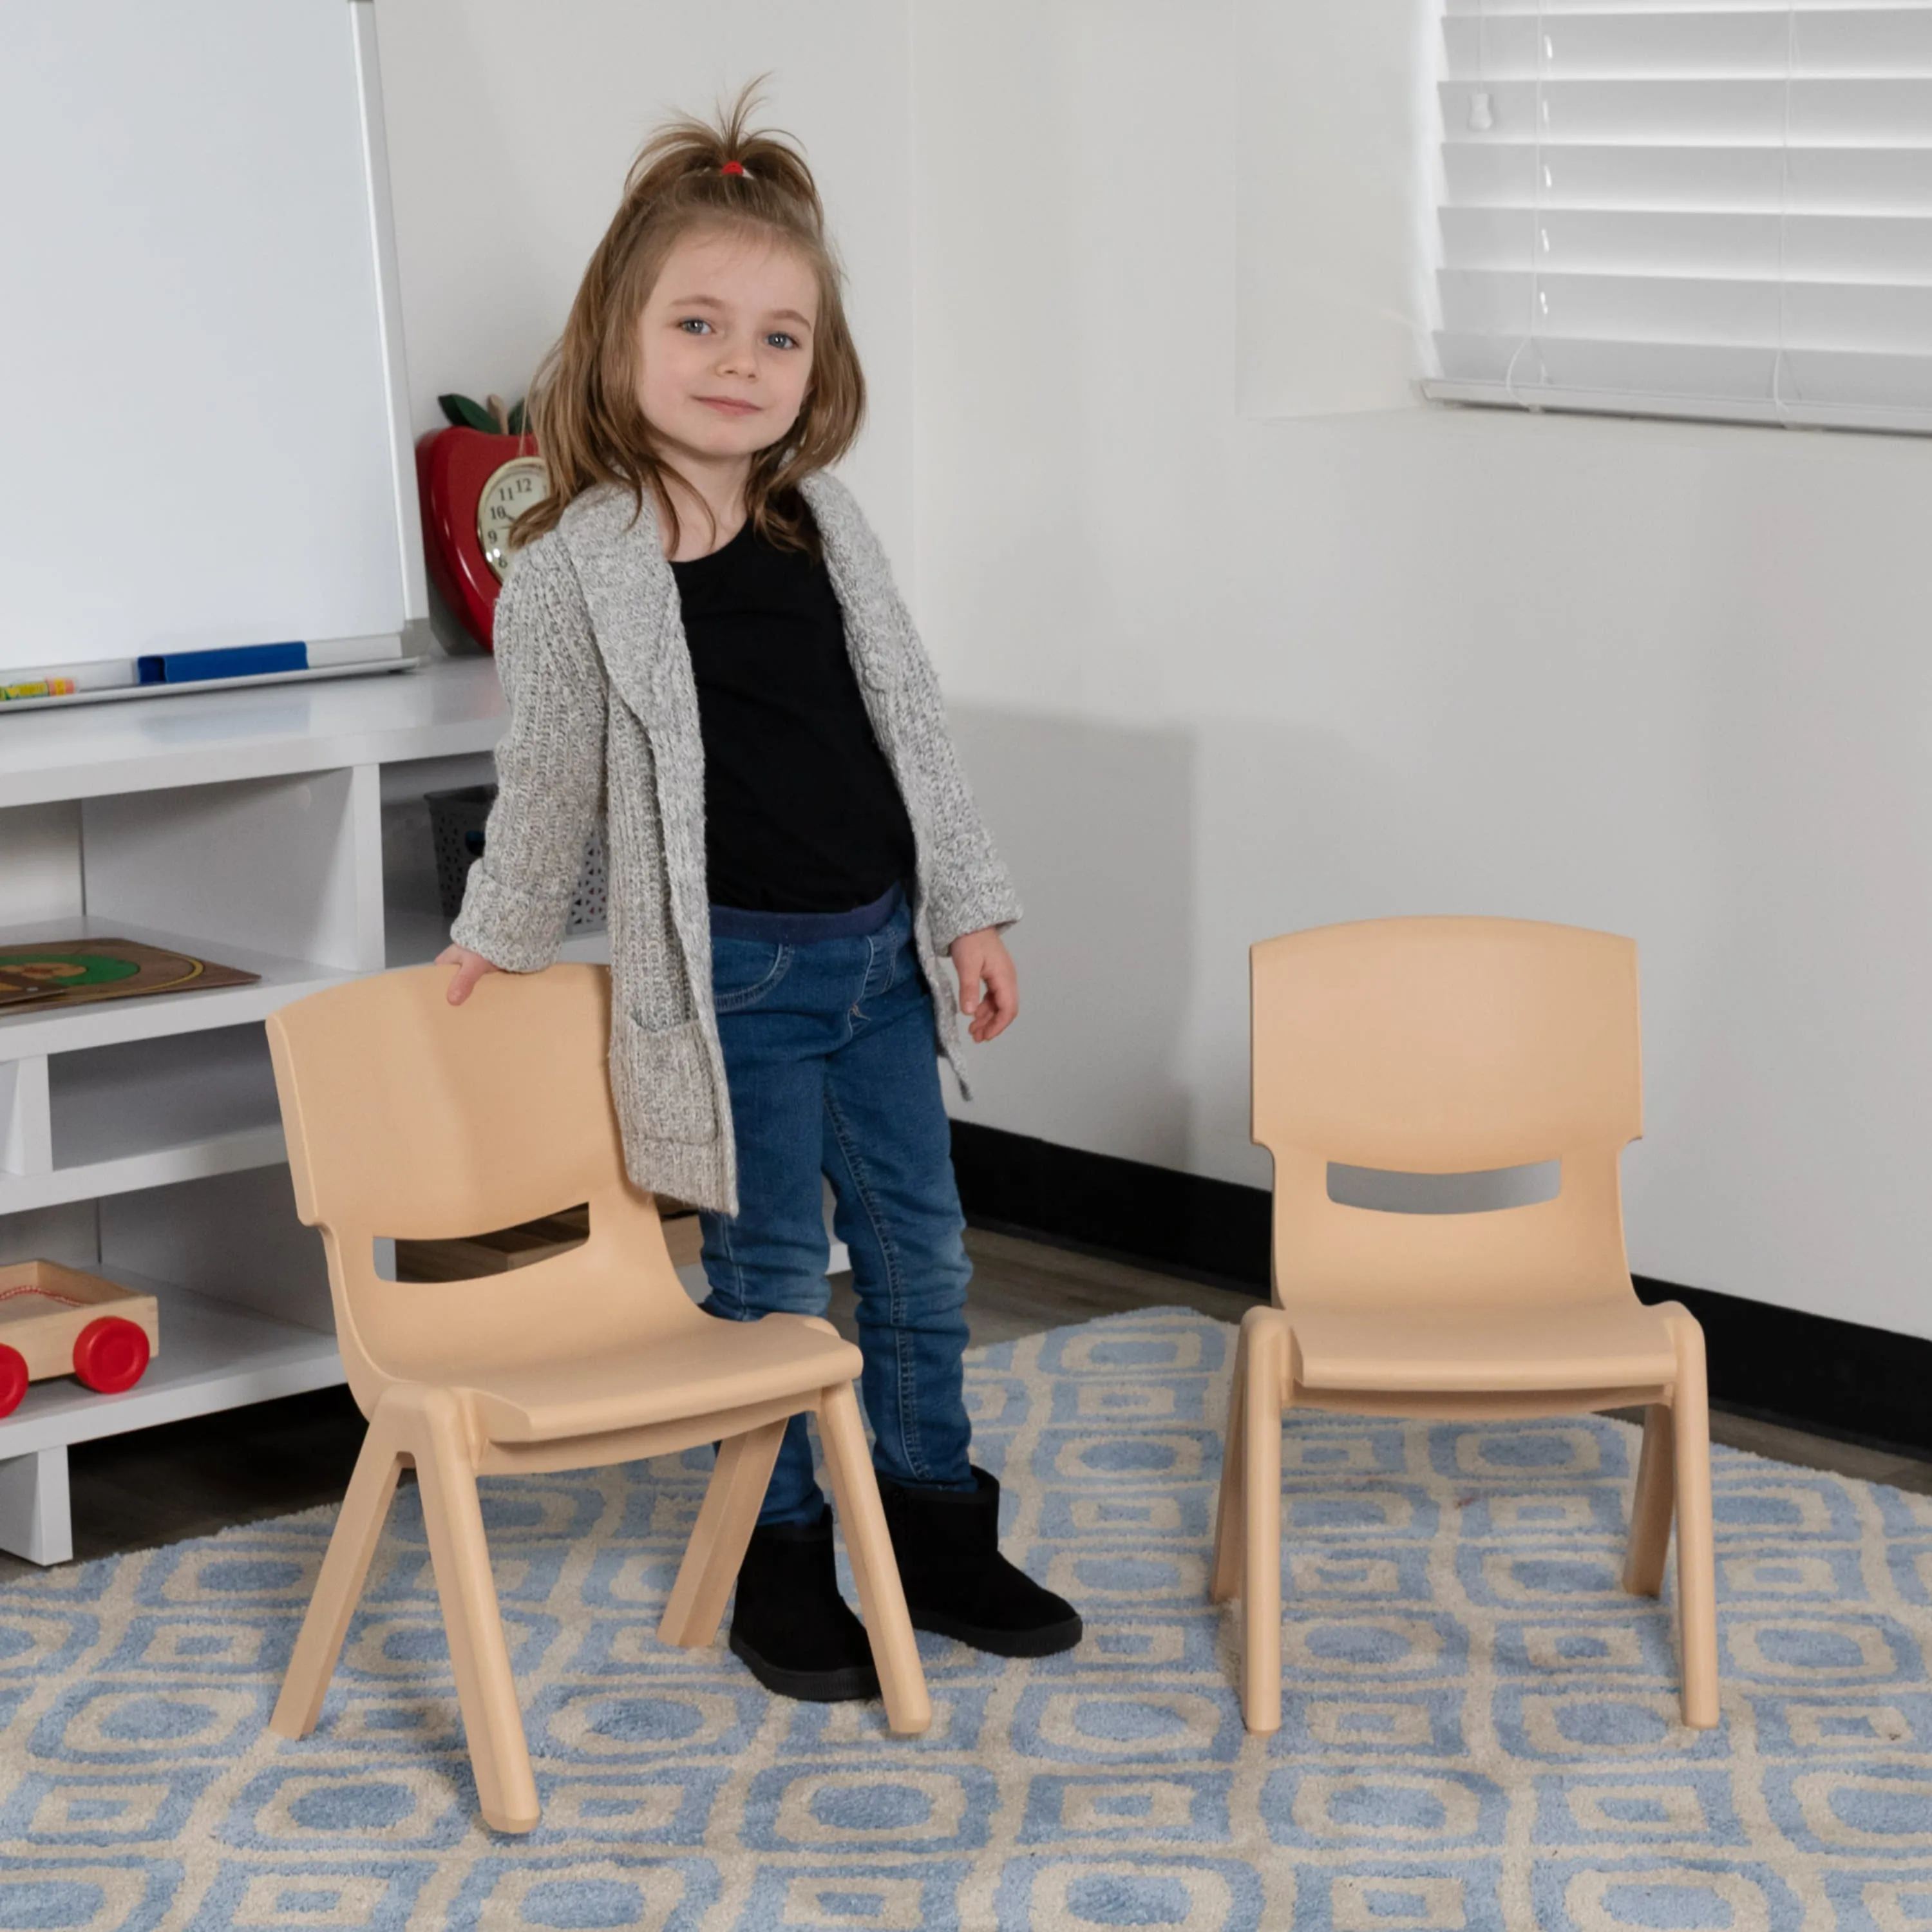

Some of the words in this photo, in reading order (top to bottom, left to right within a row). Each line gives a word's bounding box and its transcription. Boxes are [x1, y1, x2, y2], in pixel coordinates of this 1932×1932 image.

[516, 478, 532, 493] 12
[500, 487, 514, 501] 11
[490, 506, 506, 520] 10
[488, 529, 498, 544] 9
